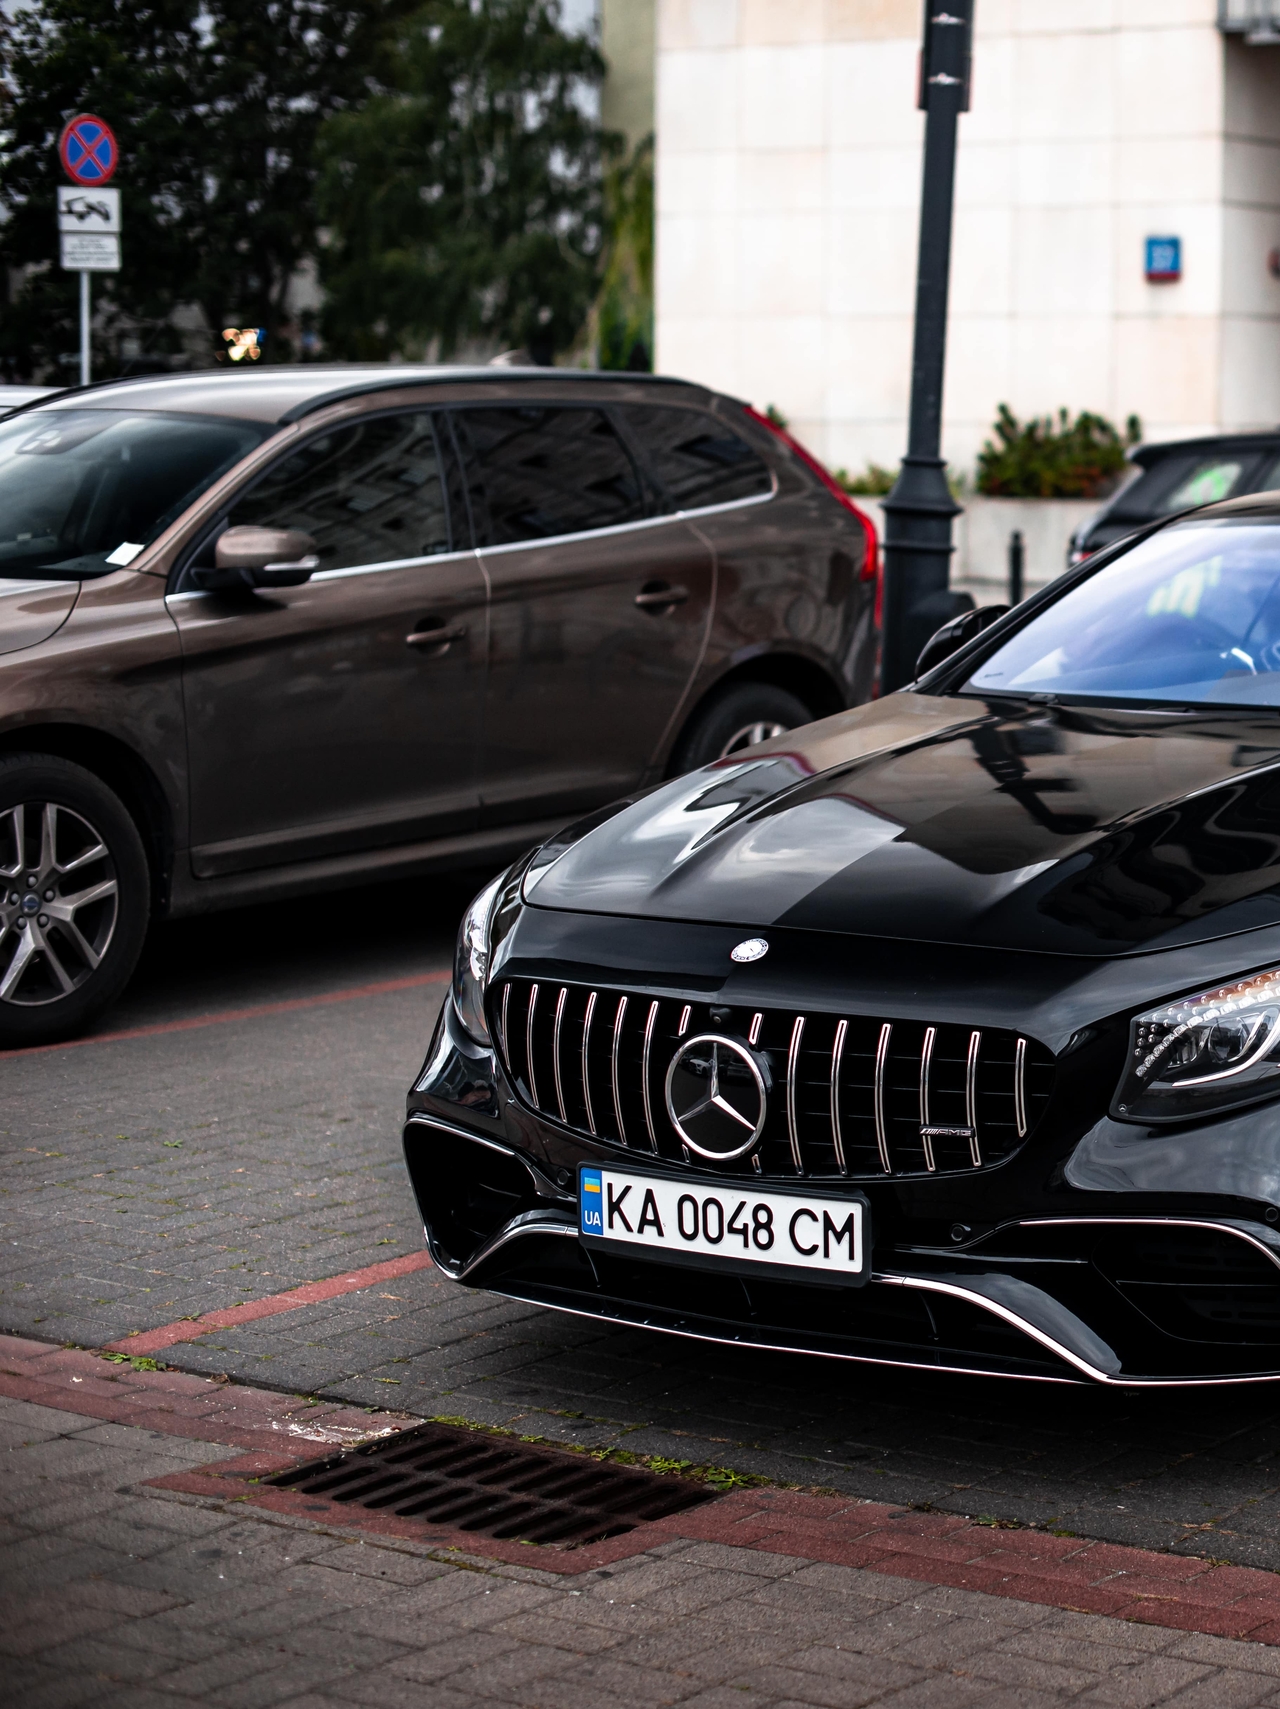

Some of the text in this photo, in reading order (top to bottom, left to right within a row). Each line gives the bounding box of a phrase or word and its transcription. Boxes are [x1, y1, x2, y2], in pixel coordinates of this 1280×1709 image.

[585, 1210, 601, 1226] UA
[607, 1182, 855, 1261] KA 0048 CM
